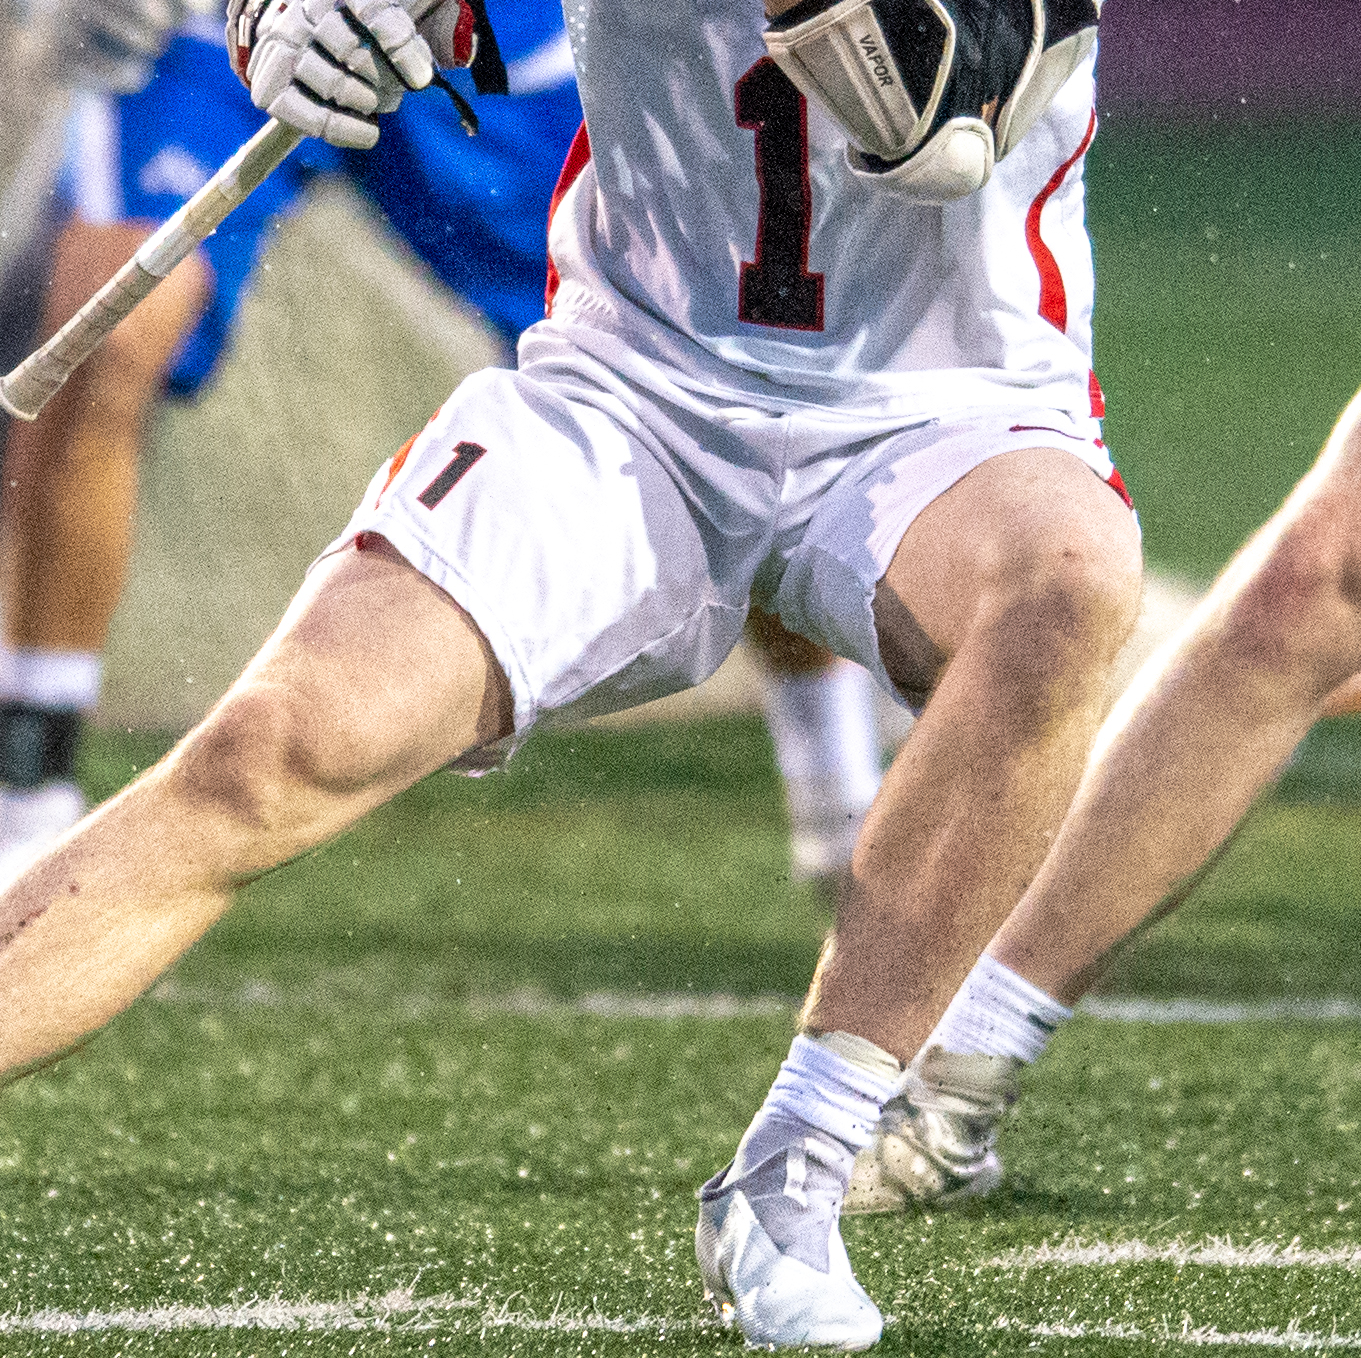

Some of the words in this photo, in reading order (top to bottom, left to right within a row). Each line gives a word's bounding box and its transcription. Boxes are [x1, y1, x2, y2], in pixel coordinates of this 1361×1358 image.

[859, 33, 895, 88] VAPOR
[735, 56, 824, 332] 1
[416, 440, 488, 512] 1
